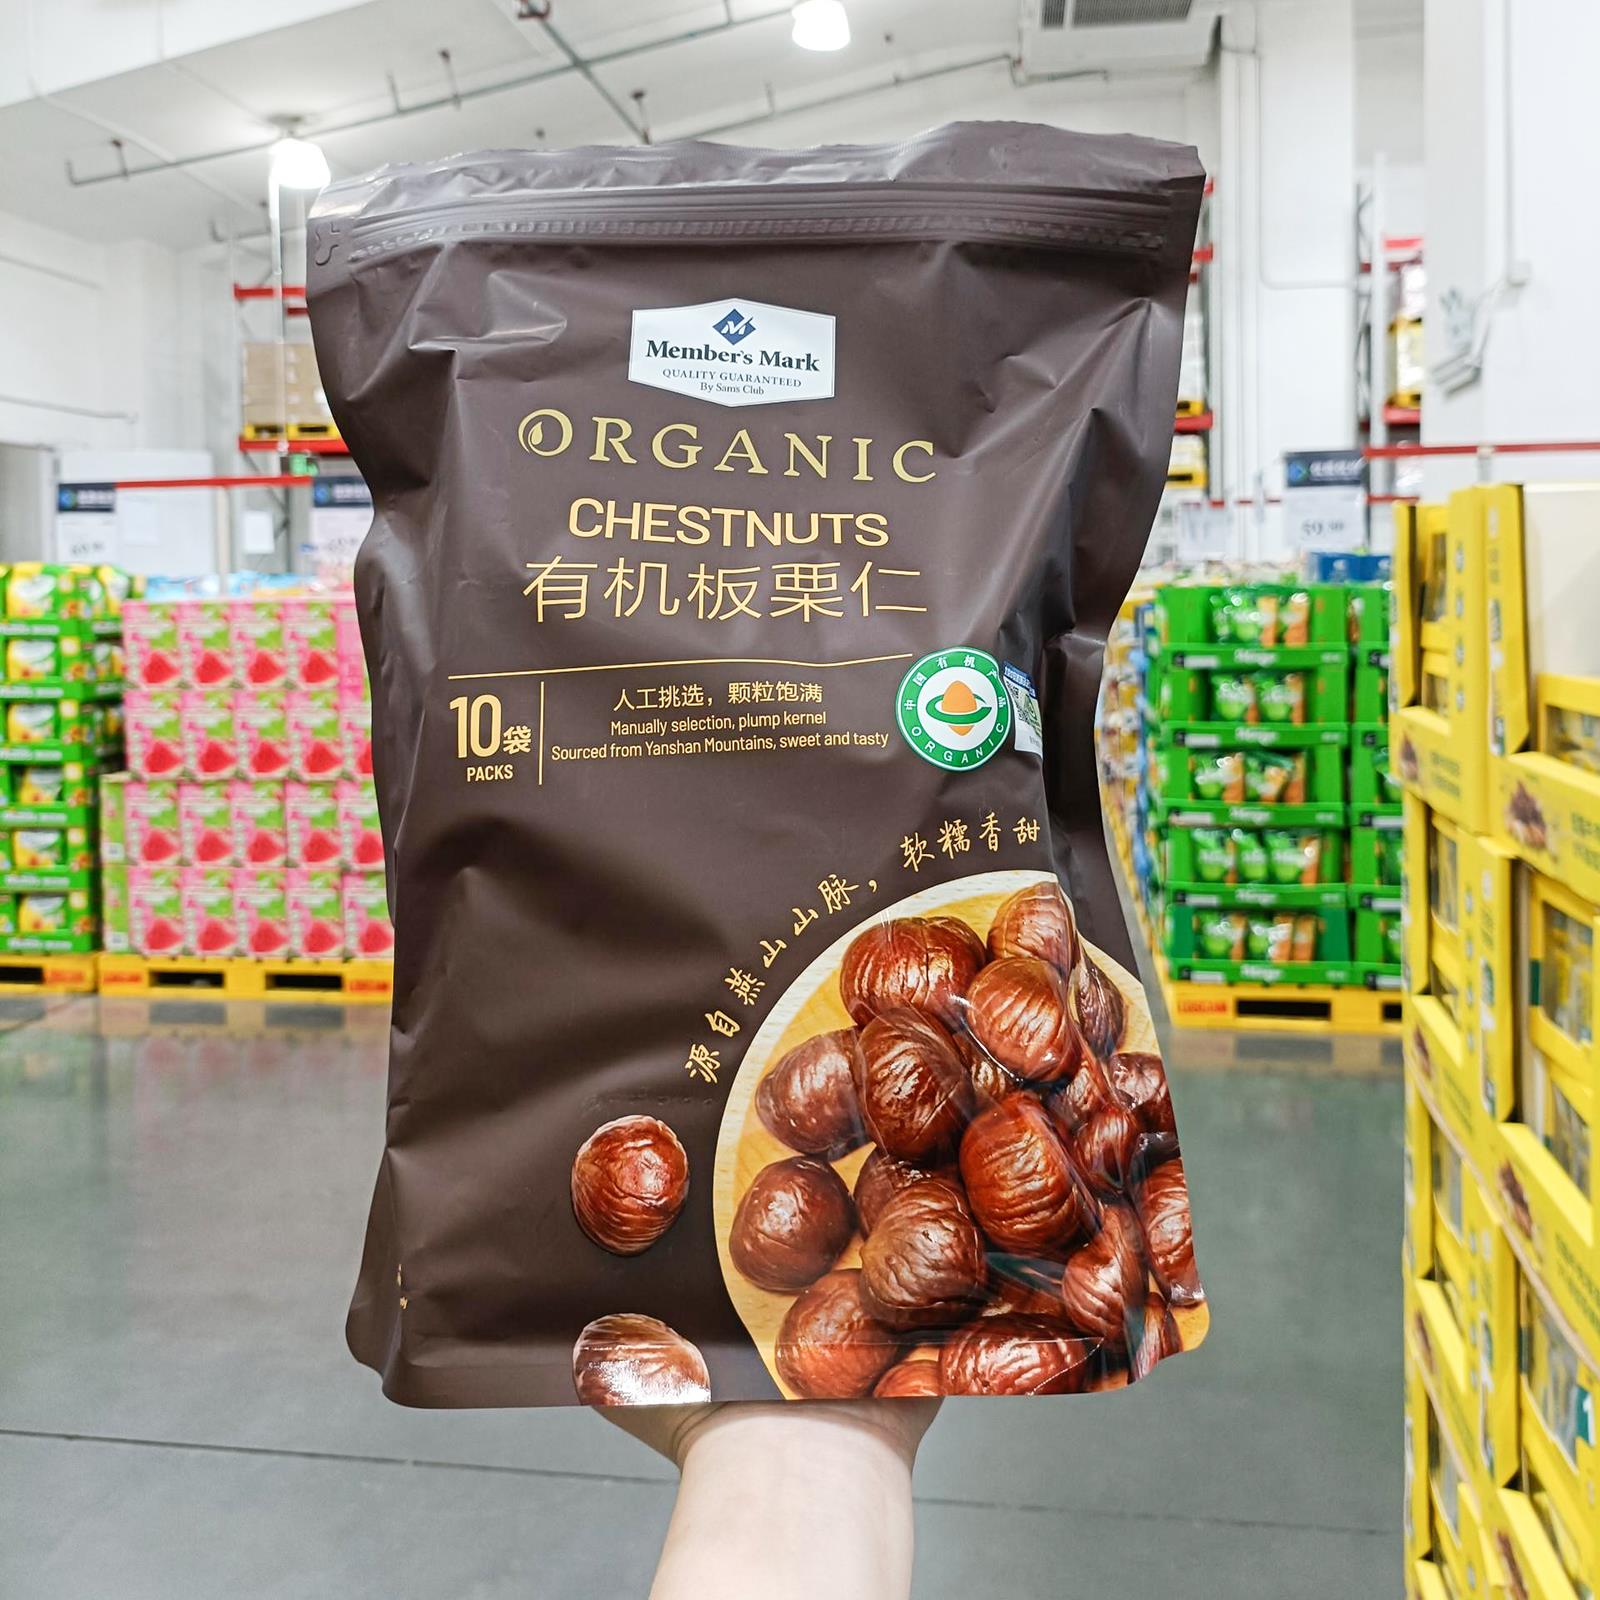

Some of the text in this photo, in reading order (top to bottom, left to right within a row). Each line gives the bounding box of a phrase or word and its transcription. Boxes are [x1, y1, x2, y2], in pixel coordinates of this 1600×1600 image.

[645, 339, 820, 372] Member's Mark
[662, 368, 802, 388] QUALITY GUARANTEED
[700, 382, 713, 393] By
[742, 385, 765, 395] Club
[518, 409, 937, 483] ORGANIC
[568, 497, 890, 548] CHESTNUTS
[522, 555, 928, 623] 有机板栗仁
[613, 680, 823, 711] 人工挑选，颗粒饱满
[611, 711, 826, 736] Manually selection, plump kernel
[551, 731, 889, 761] Sourced from Yanshan Mountains, sweet and tasty
[911, 723, 1004, 763] ORGANIC
[466, 763, 514, 782] PACKS
